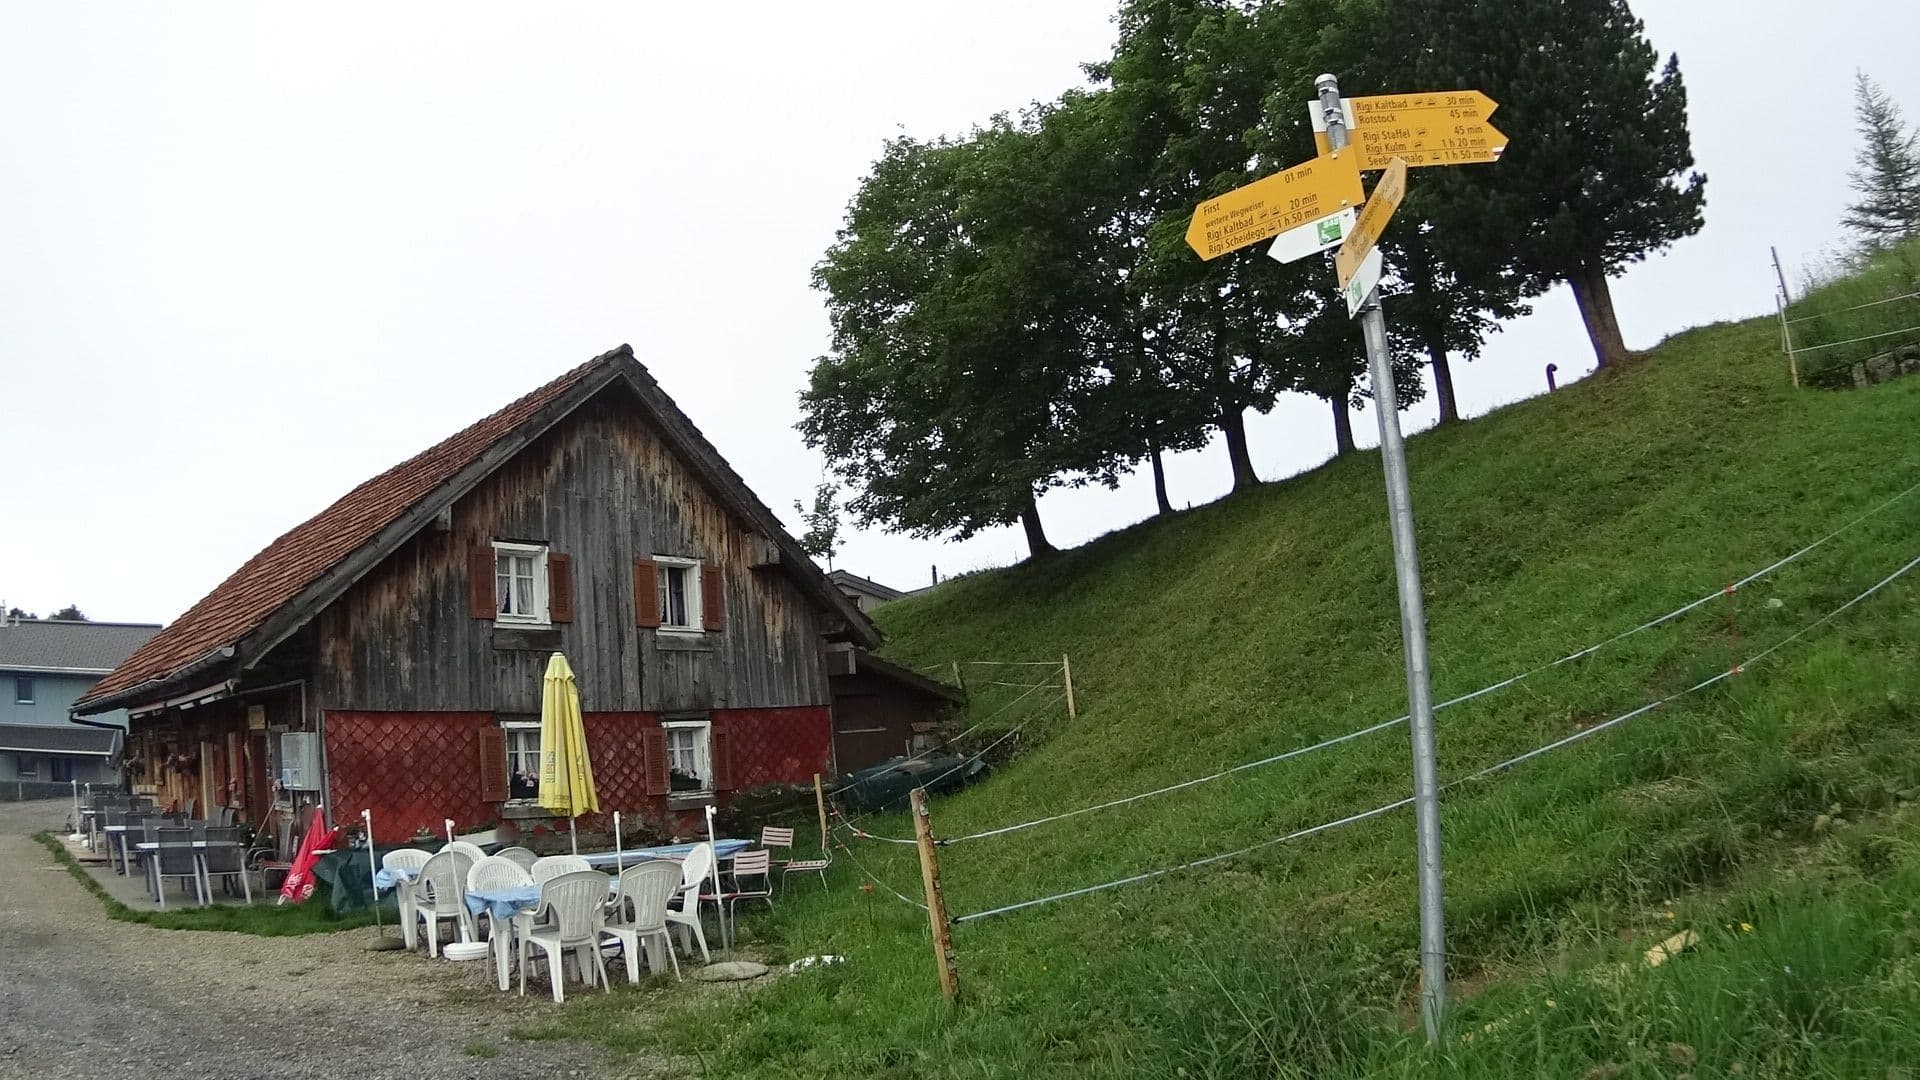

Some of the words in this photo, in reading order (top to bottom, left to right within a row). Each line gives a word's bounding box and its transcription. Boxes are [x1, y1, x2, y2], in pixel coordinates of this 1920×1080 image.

[1356, 101, 1373, 112] Rigi
[1375, 99, 1408, 109] Kaltbad
[1447, 97, 1457, 105] 30
[1459, 96, 1475, 104] min
[1359, 115, 1396, 124] Rotstock
[1450, 110, 1460, 118] 45
[1463, 109, 1478, 118] min
[1363, 132, 1380, 141] Rigi
[1382, 129, 1410, 140] Staffel
[1454, 126, 1465, 135] 45
[1467, 125, 1483, 134] min
[1366, 144, 1382, 153] Rigi
[1385, 142, 1406, 152] Kulm
[1450, 139, 1455, 147] h
[1458, 138, 1468, 147] 20
[1470, 137, 1486, 145] min
[1368, 153, 1424, 166] Seebenalp
[1453, 151, 1458, 159] h
[1461, 150, 1471, 159] 50
[1473, 149, 1489, 158] min
[1203, 202, 1220, 216] First
[1284, 175, 1295, 183] 01
[1297, 167, 1312, 180] min
[1205, 214, 1229, 228] weitere
[1229, 200, 1264, 219] Wegweiser
[1207, 228, 1223, 242] Rigi
[1223, 216, 1253, 233] Kaltbad
[1289, 198, 1300, 210] 20
[1302, 192, 1318, 205] min
[1209, 240, 1224, 254] Rigi
[1226, 227, 1266, 247] Scheidegg
[1284, 217, 1291, 227] h
[1292, 213, 1303, 224] 50
[1304, 207, 1320, 219] min
